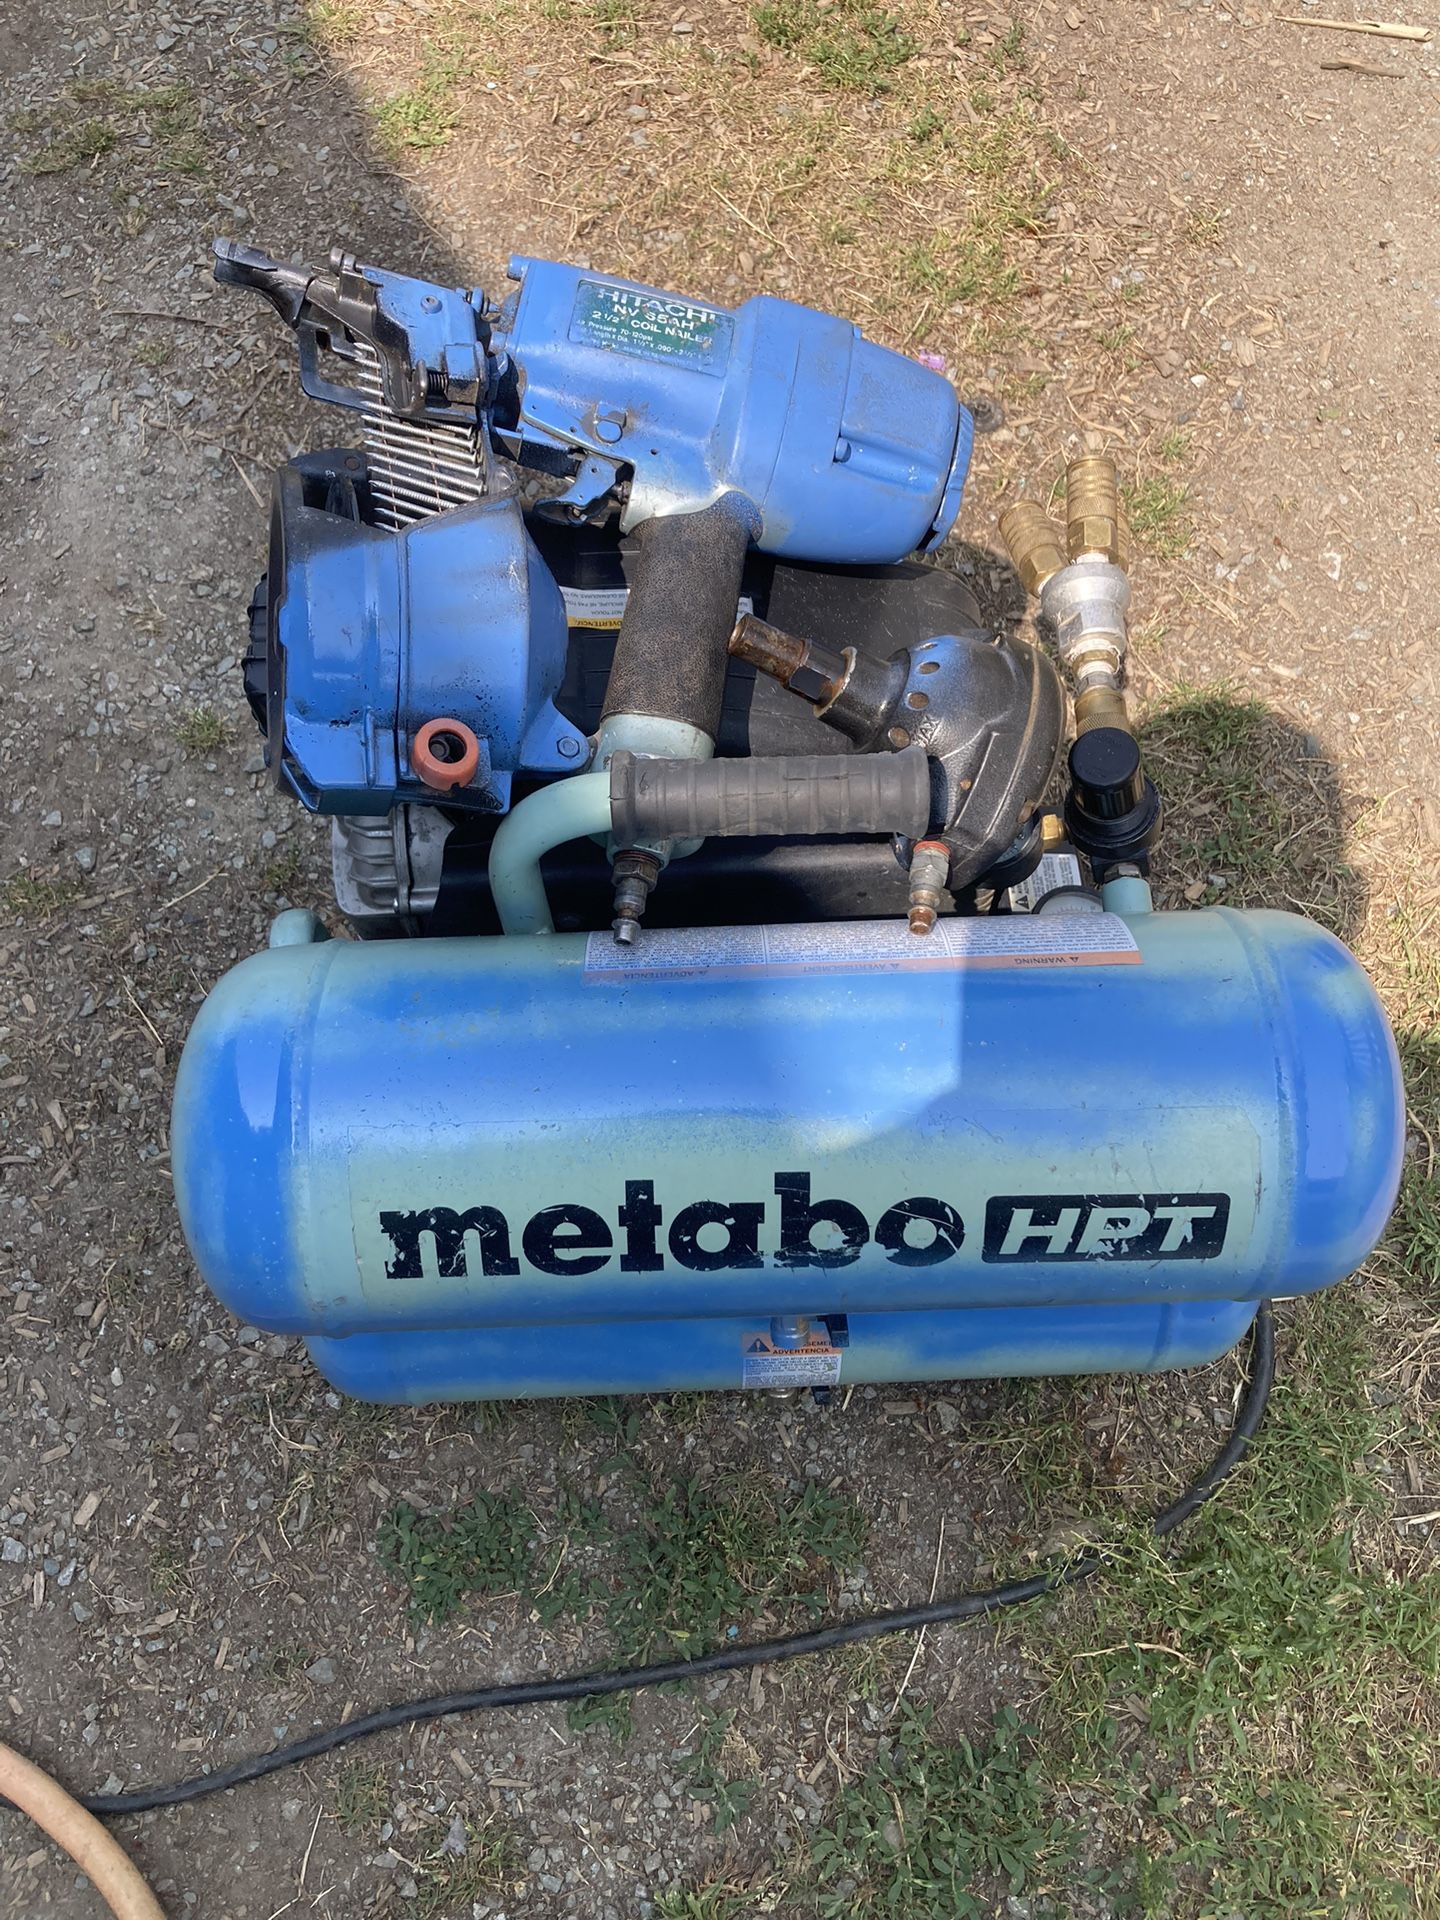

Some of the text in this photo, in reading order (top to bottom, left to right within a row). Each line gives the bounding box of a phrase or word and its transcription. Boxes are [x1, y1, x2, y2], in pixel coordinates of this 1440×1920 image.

[596, 288, 716, 323] HITACHI
[613, 304, 640, 317] NV
[630, 319, 662, 334] COIL
[665, 327, 713, 346] NAILER
[1014, 956, 1066, 966] WARNING
[624, 970, 695, 980] ADVERTENCIA
[380, 1172, 1217, 1279] metabo HPT
